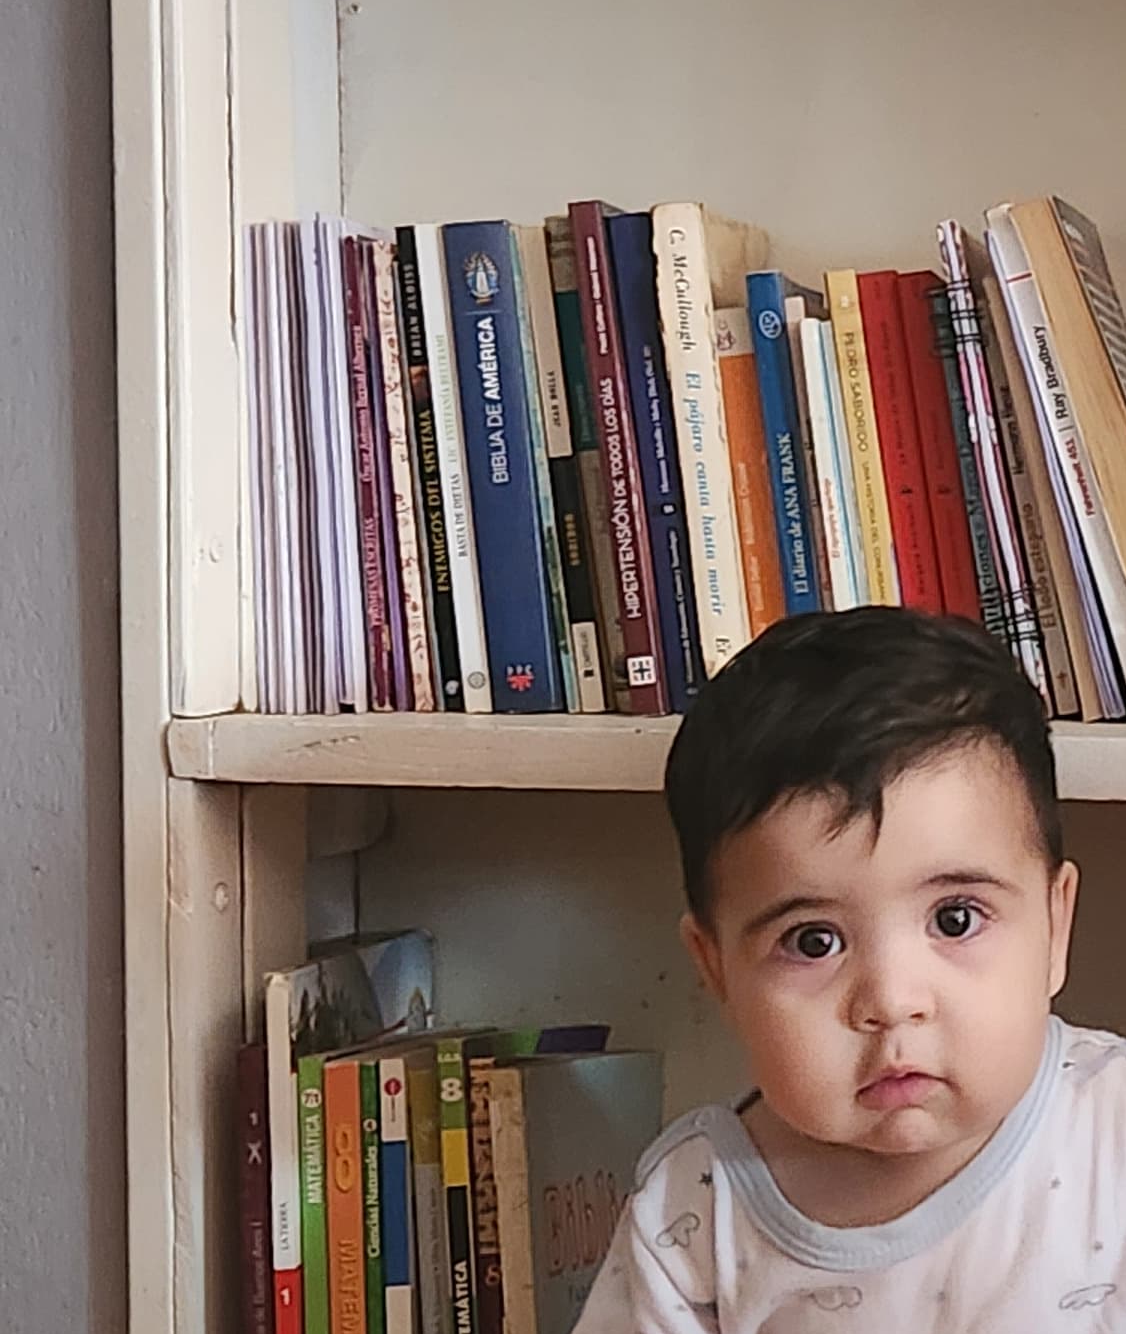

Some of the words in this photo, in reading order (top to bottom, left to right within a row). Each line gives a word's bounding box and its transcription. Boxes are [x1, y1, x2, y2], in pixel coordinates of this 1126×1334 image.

[403, 263, 418, 310] ALDISS
[671, 253, 697, 351] McCullough
[409, 315, 423, 357] BRIAN
[477, 316, 501, 400] AMÉRICA
[843, 331, 859, 379] PEDRO
[1033, 326, 1060, 390] Bradbury
[599, 377, 615, 406] DÍAS
[685, 372, 702, 389] El
[484, 402, 504, 428] DE
[603, 407, 619, 433] LOS
[682, 397, 705, 453] pájaro
[849, 381, 869, 453] SABORIDO
[1052, 392, 1069, 420] Ray
[418, 409, 437, 473] SISTEMA
[488, 429, 509, 484] BIBLIA
[606, 433, 624, 477] TODOS
[776, 432, 796, 484] FRANK
[1065, 437, 1078, 460] 451
[425, 479, 440, 506] DEL
[450, 473, 463, 509] DIETAS
[612, 478, 627, 497] DE
[695, 461, 710, 507] canta
[783, 485, 801, 520] ANA
[1072, 461, 1096, 516] Fahrenheit
[454, 512, 465, 525] DE
[701, 515, 717, 560] hasta
[787, 521, 803, 538] de
[1022, 499, 1051, 574] estepario
[429, 510, 450, 592] ENEMIGOS
[456, 526, 469, 558] BASTA
[611, 498, 642, 619] HIPERTENSIÓN
[791, 539, 807, 578] diario
[707, 569, 722, 616] morir
[792, 580, 809, 594] El
[1032, 575, 1053, 611] lobo
[1039, 612, 1057, 629] El
[440, 1077, 464, 1102] 8
[303, 1112, 324, 1205] MATEMÁTICA
[334, 1123, 353, 1194] 8
[364, 1143, 379, 1206] Naturales
[280, 1237, 290, 1251] LA
[366, 1206, 381, 1259] Ciencias
[280, 1287, 290, 1306] 1
